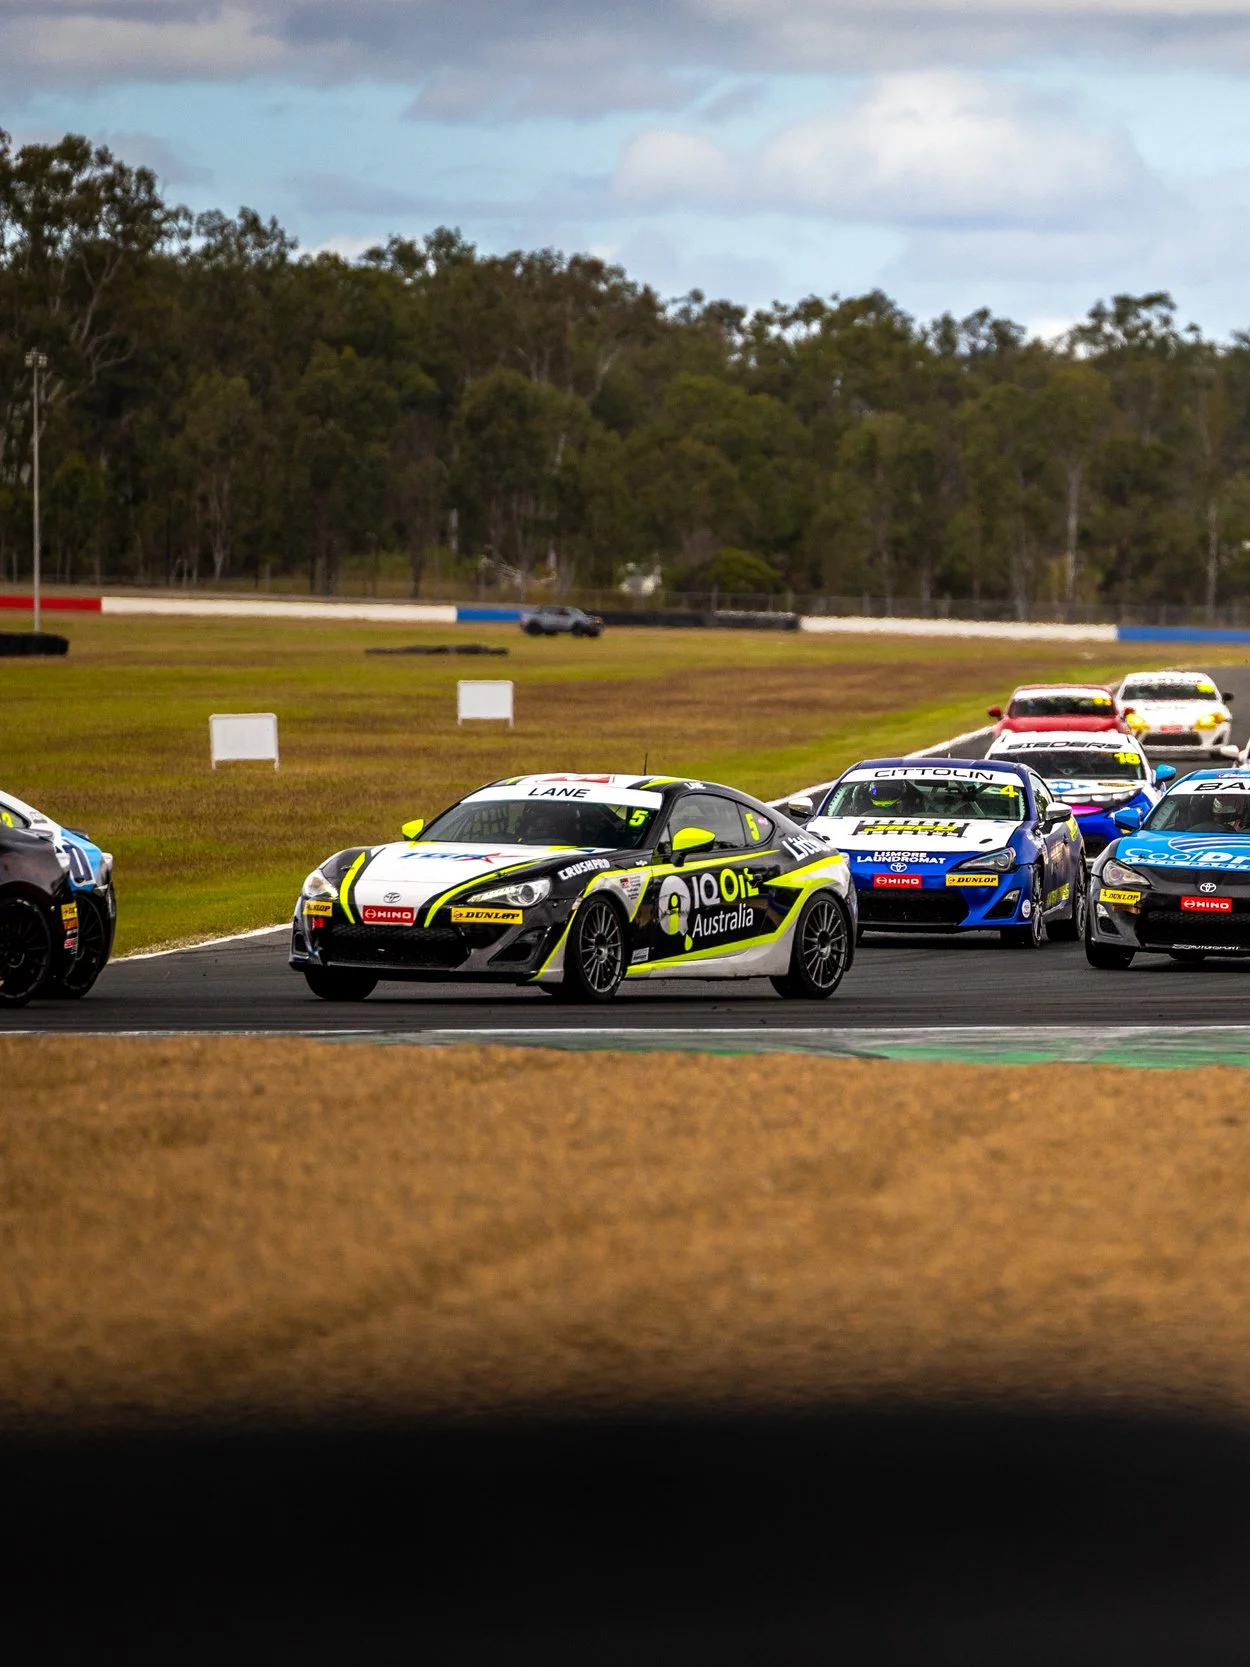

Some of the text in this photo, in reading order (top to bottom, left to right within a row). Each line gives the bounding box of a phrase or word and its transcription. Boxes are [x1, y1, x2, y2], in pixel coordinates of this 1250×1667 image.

[1007, 741, 1124, 750] SIEDERS
[874, 768, 994, 781] CITTOLIN
[528, 787, 591, 799] LANE
[1000, 784, 1018, 798] 4
[628, 810, 649, 827] 5
[745, 813, 760, 841] 5
[856, 855, 947, 864] LAUNDROMAT
[874, 851, 927, 859] LISMORE
[557, 858, 611, 881] CRUSHPRO
[886, 877, 919, 885] HINO
[1107, 893, 1140, 902] DUNLOP
[1196, 901, 1230, 909] HINO
[377, 911, 412, 919] HINO
[464, 911, 520, 921] DUNLOP
[692, 903, 754, 938] Australia
